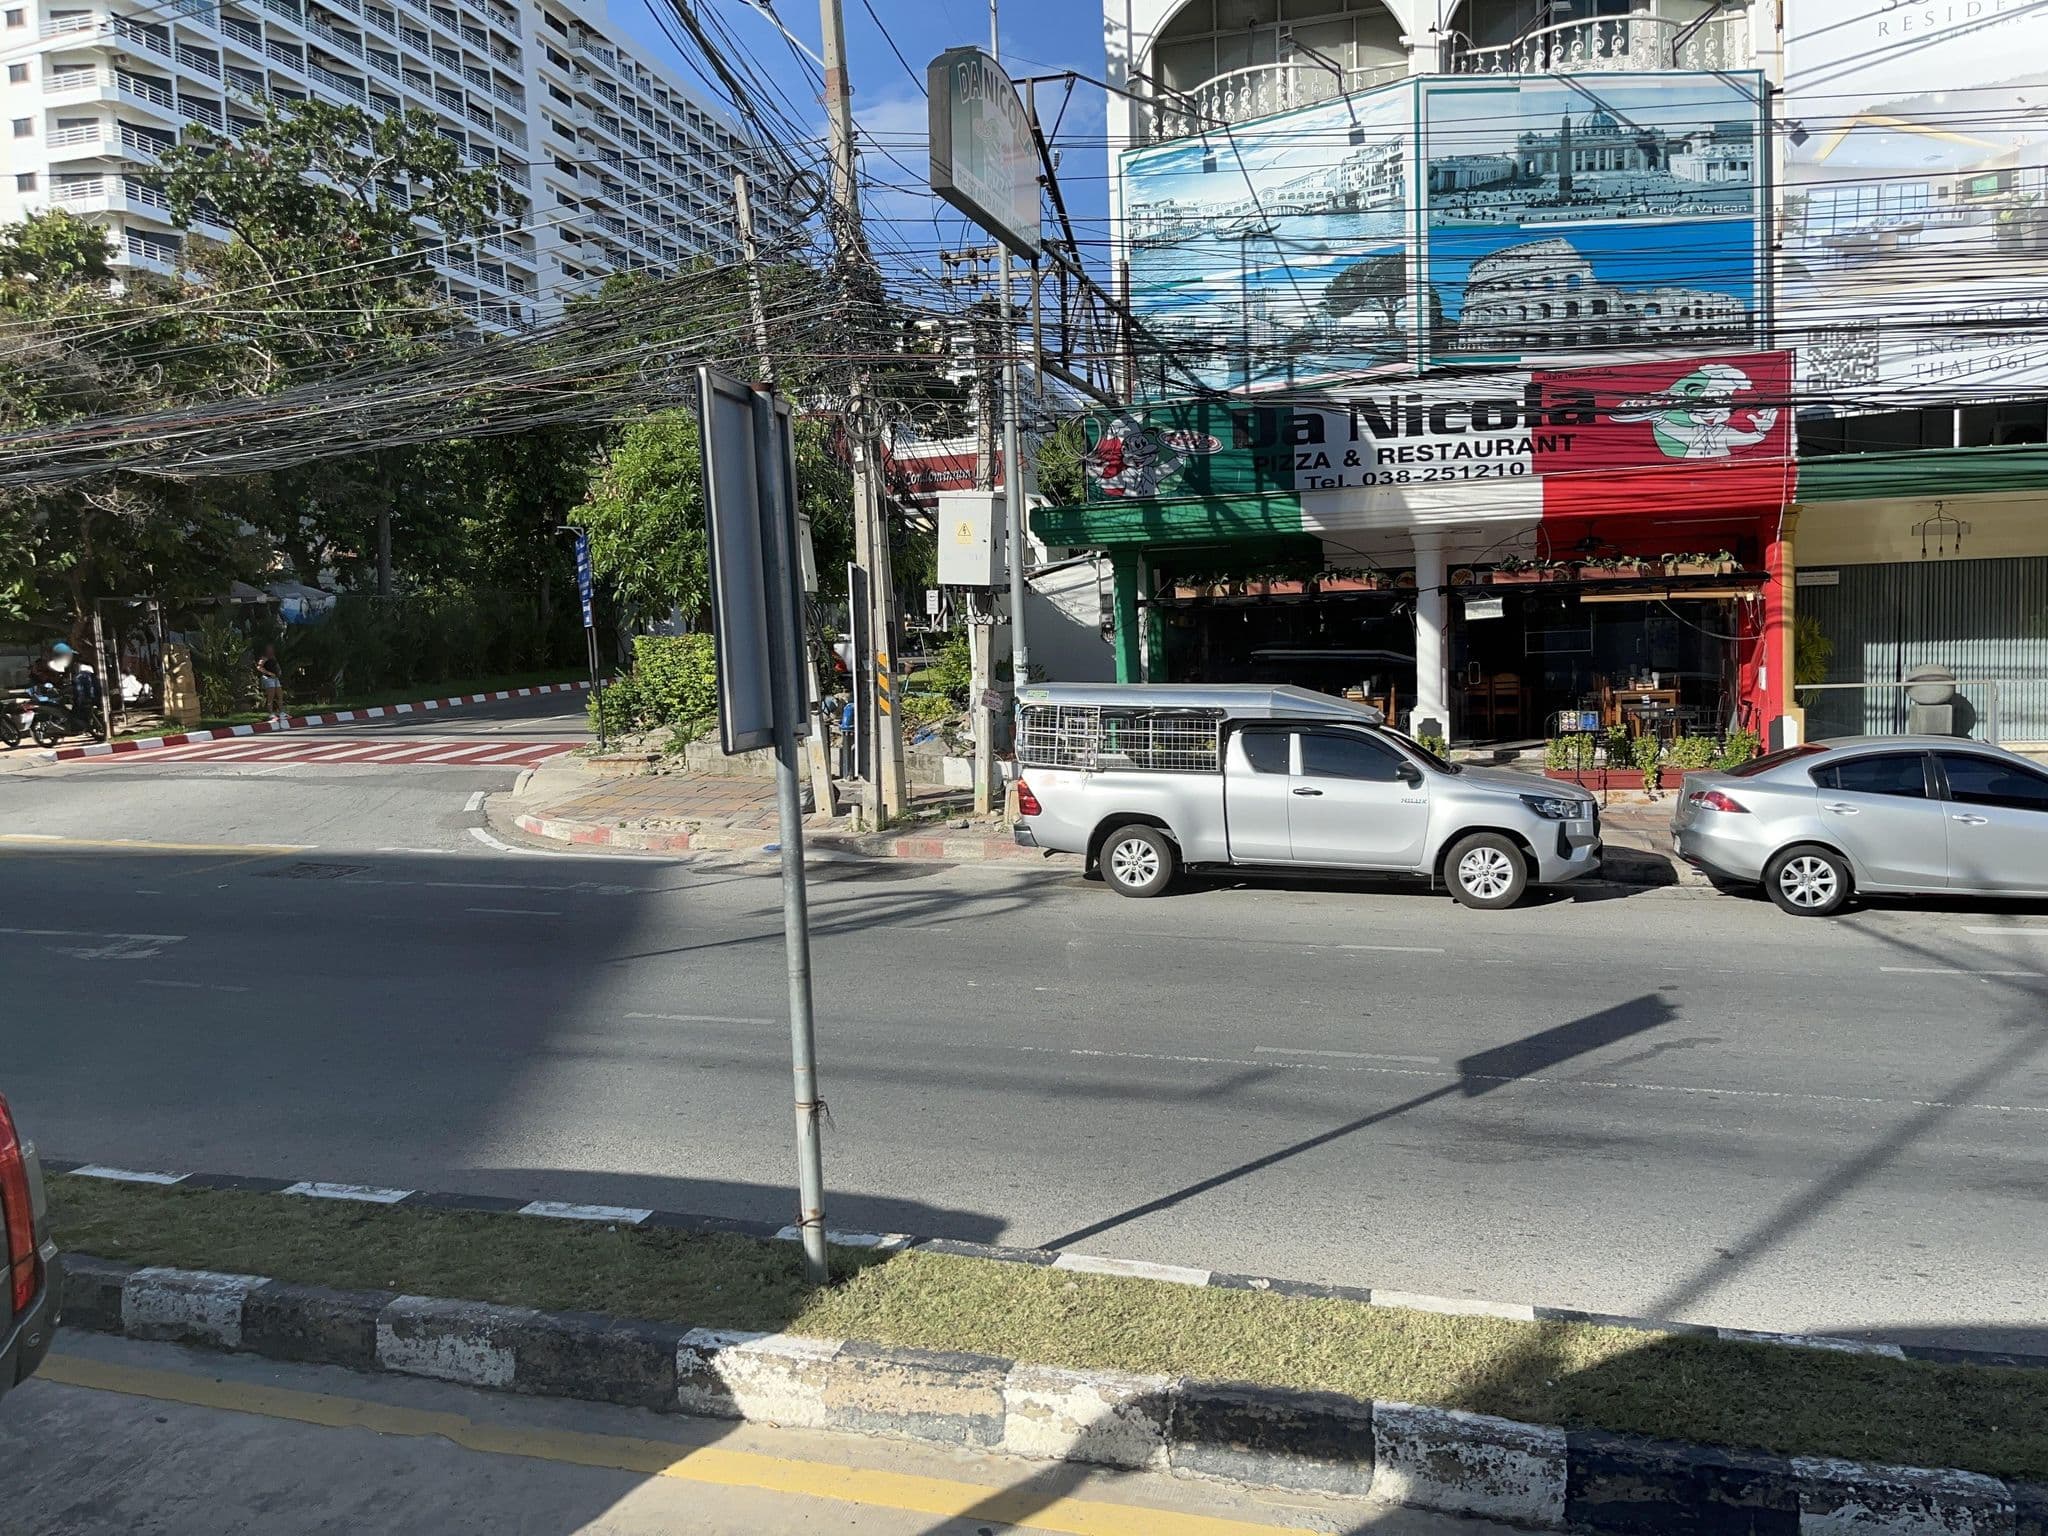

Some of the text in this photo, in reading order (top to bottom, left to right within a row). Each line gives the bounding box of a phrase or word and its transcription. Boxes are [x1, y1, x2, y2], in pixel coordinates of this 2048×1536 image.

[957, 61, 1035, 157] DA NICOLA
[1649, 203, 1748, 216] City of Vatican
[1911, 357, 1973, 378] THAI
[1349, 382, 1597, 442] Nicola
[1255, 433, 1577, 474] PIZZA & RESTAURANT
[1304, 462, 1525, 489] Tel. 038-251210
